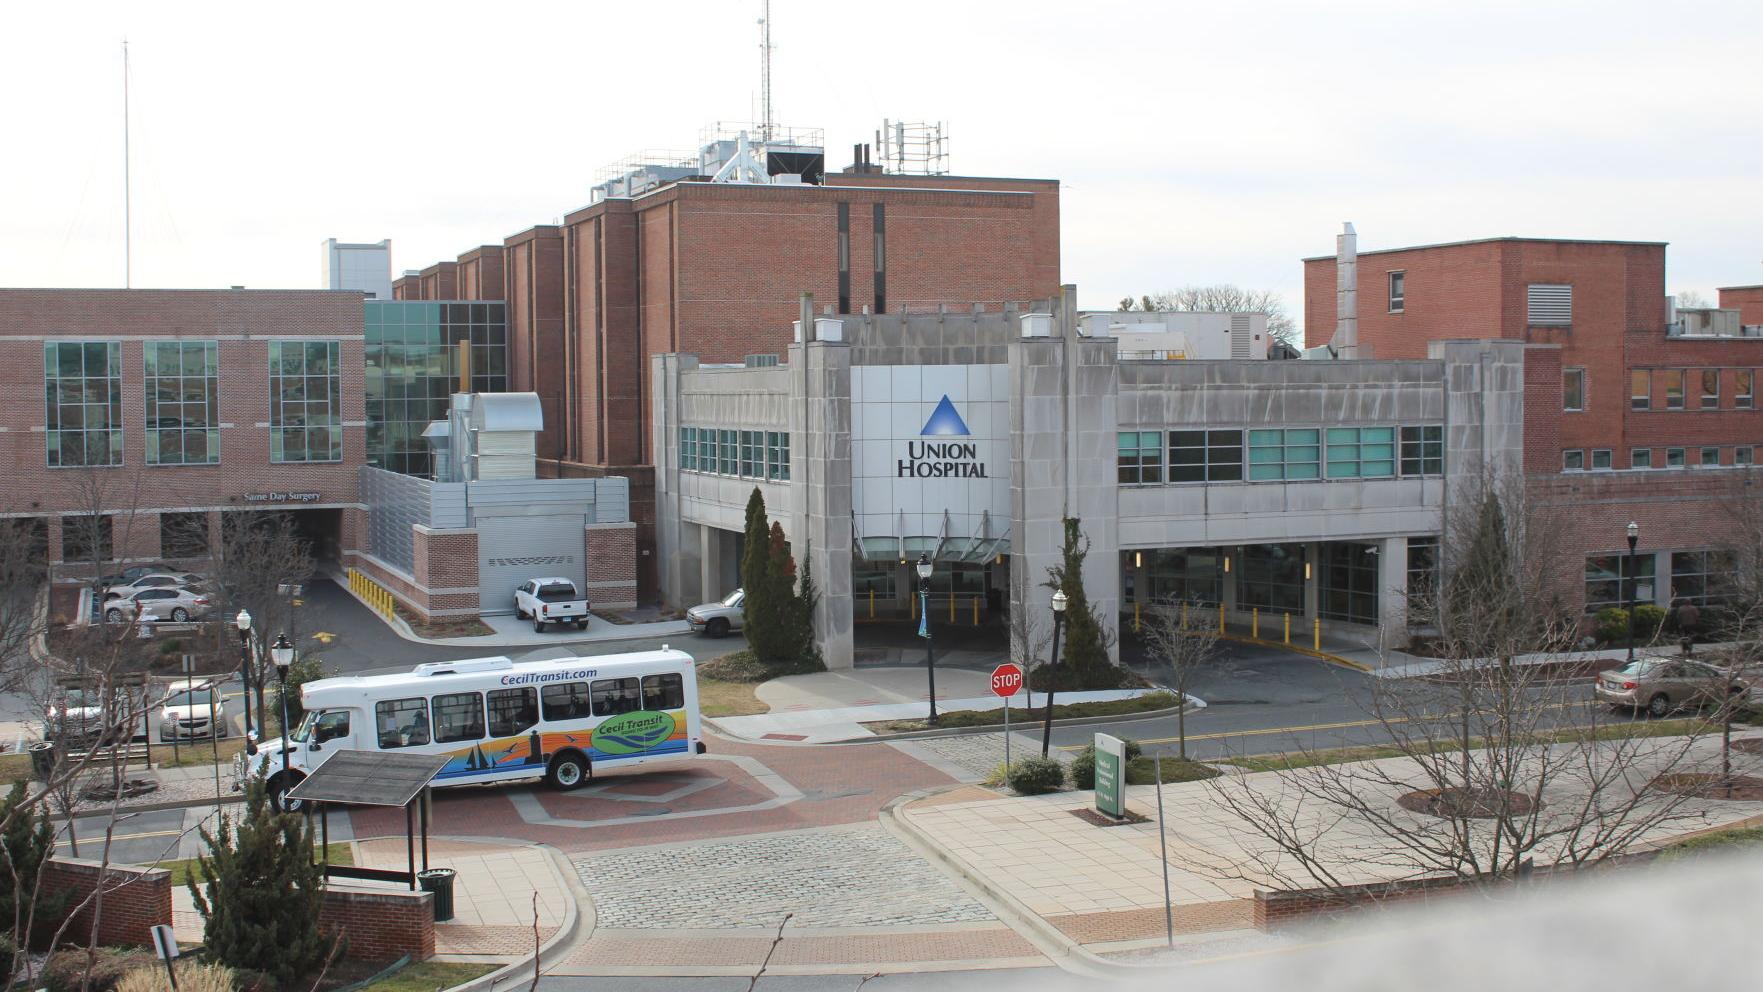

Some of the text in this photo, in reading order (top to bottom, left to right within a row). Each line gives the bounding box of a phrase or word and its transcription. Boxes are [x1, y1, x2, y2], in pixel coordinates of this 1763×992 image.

[908, 441, 976, 459] UNION
[898, 460, 988, 478] HOSPITAL
[243, 491, 320, 502] Same Day Surgery
[501, 669, 597, 685] CecilTransit.com
[993, 673, 1020, 689] STOP
[599, 722, 624, 735] Cecil
[627, 715, 663, 729] Transit
